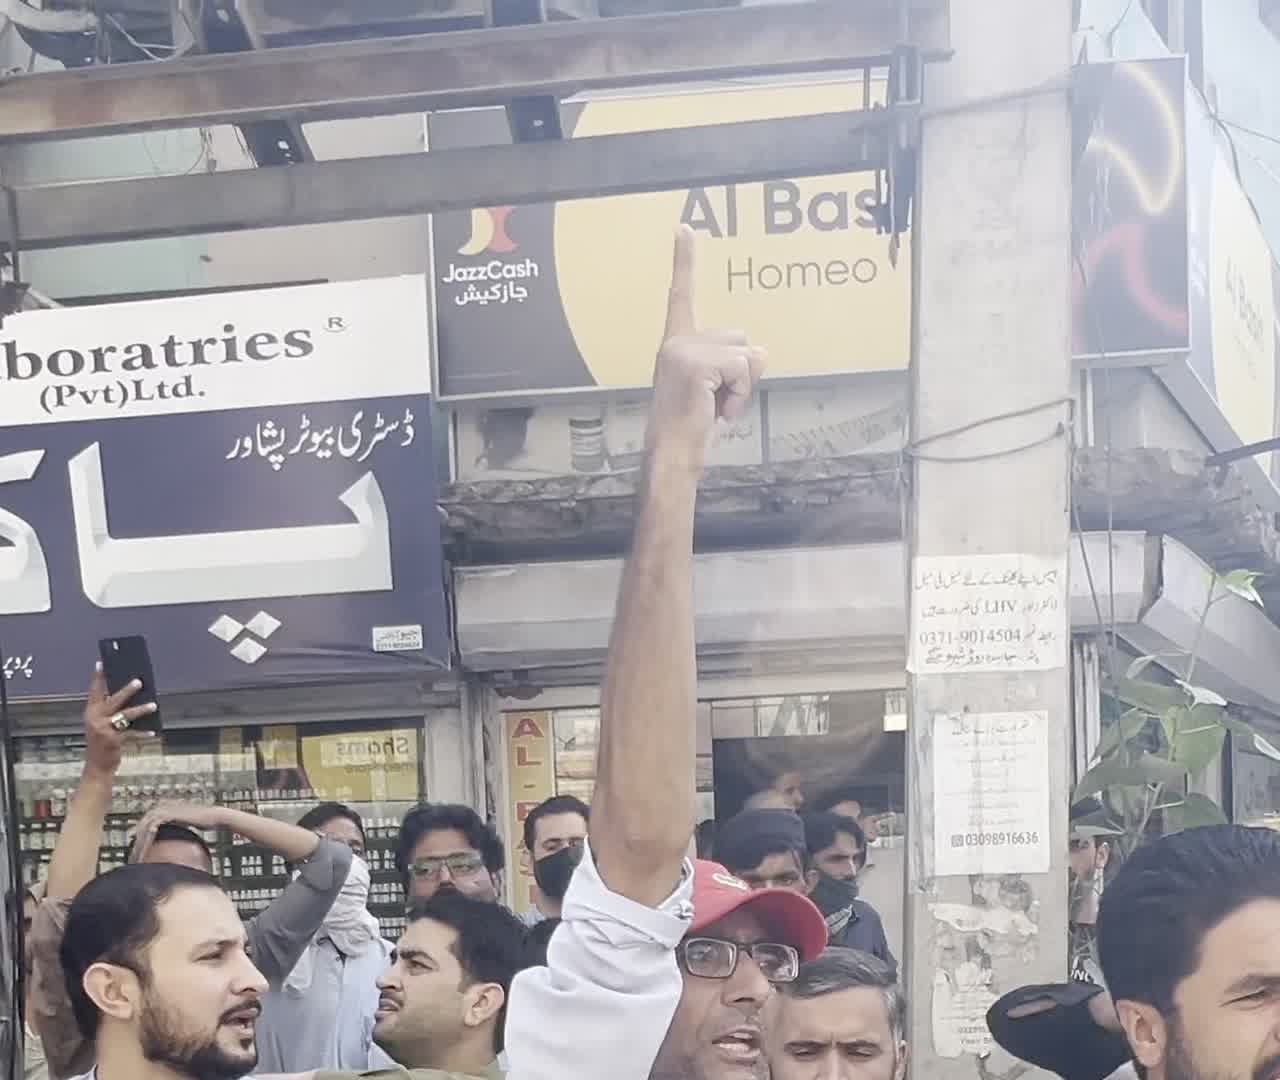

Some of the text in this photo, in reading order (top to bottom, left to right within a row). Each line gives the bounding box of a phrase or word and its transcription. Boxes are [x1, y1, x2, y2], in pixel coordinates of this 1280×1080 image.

[763, 180, 881, 236] Bas
[442, 258, 539, 283] JazzCash
[727, 254, 878, 293] Homeo
[225, 419, 285, 471] پشاور
